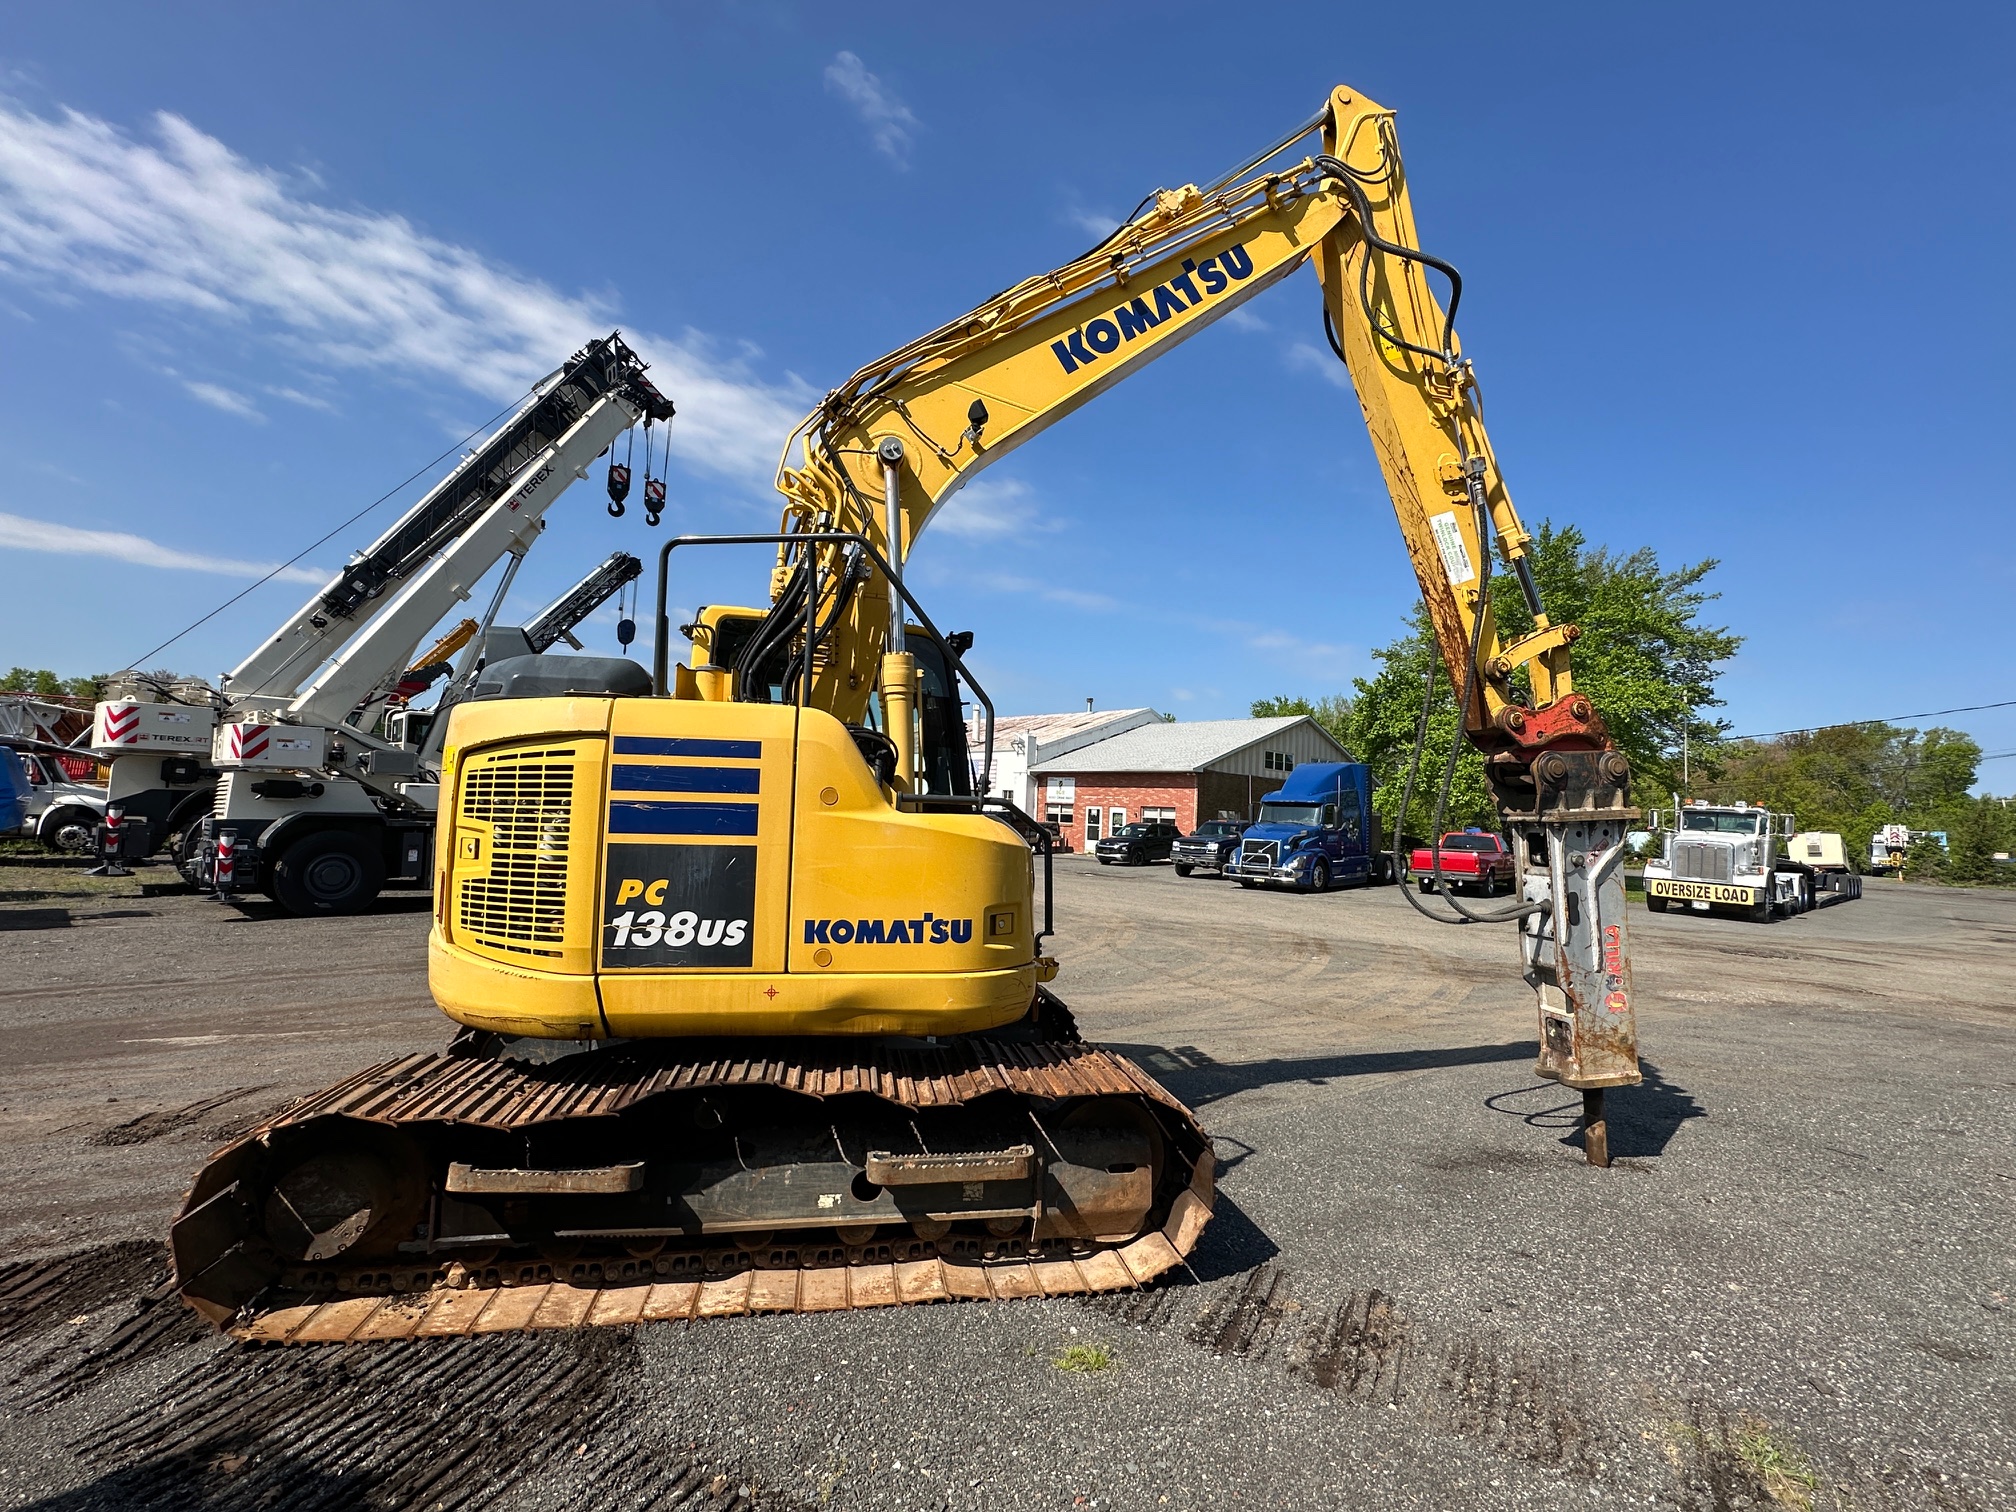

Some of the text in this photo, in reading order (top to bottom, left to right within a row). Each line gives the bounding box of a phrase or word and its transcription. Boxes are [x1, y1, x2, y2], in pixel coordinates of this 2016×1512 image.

[1050, 243, 1254, 374] KOMATSU
[516, 464, 555, 499] TEREX
[152, 734, 191, 743] TEREX
[615, 879, 669, 906] PC
[1656, 882, 1749, 903] OVERSIZE LOAD
[804, 912, 973, 944] KOMATSU
